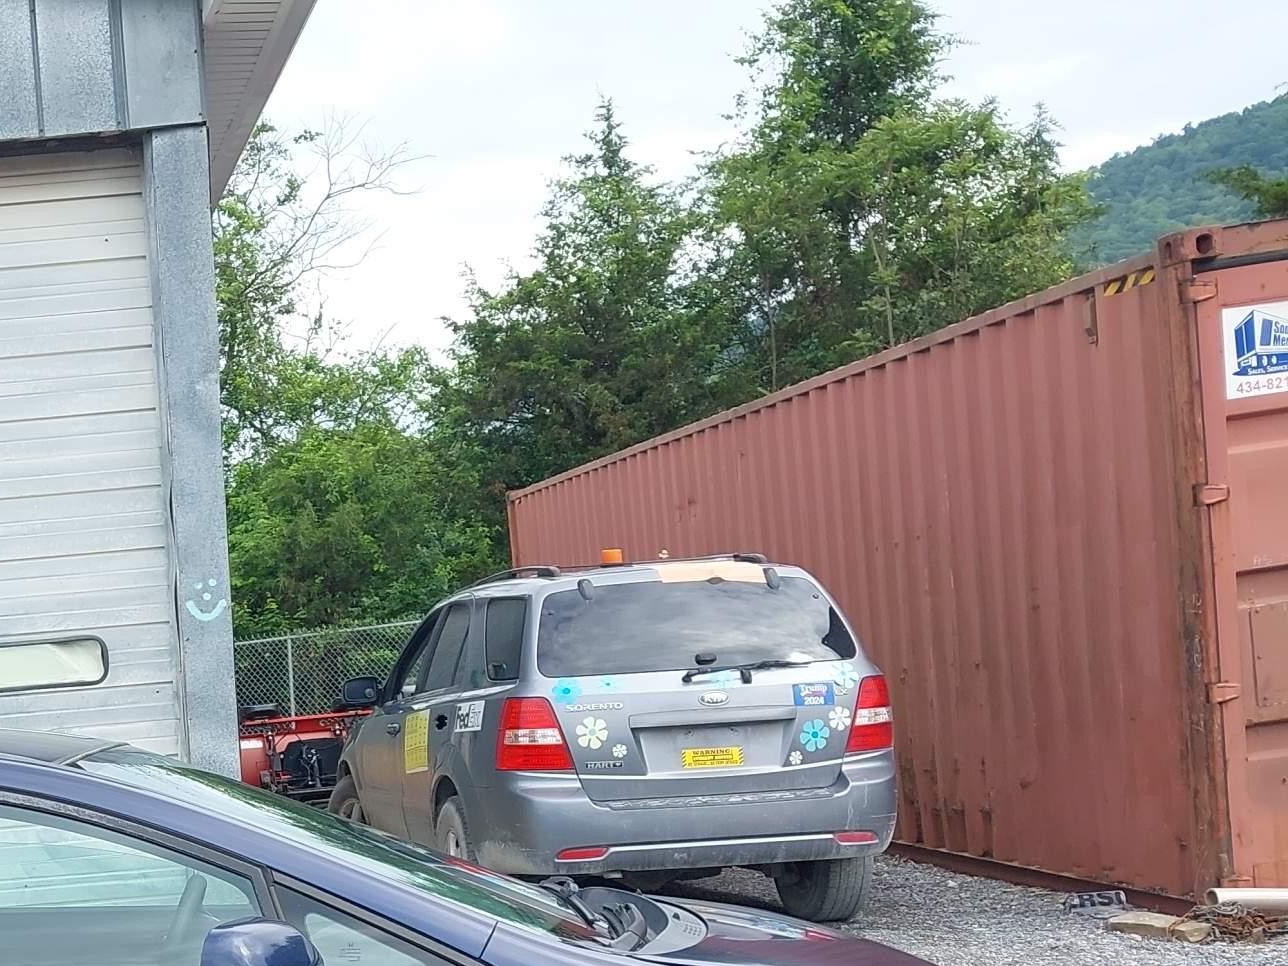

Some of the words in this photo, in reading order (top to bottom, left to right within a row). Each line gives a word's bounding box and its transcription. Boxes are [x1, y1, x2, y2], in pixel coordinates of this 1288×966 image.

[799, 683, 827, 697] Trump
[804, 696, 824, 705] 2024
[566, 702, 624, 712] SORENTO
[692, 748, 731, 756] WARNING
